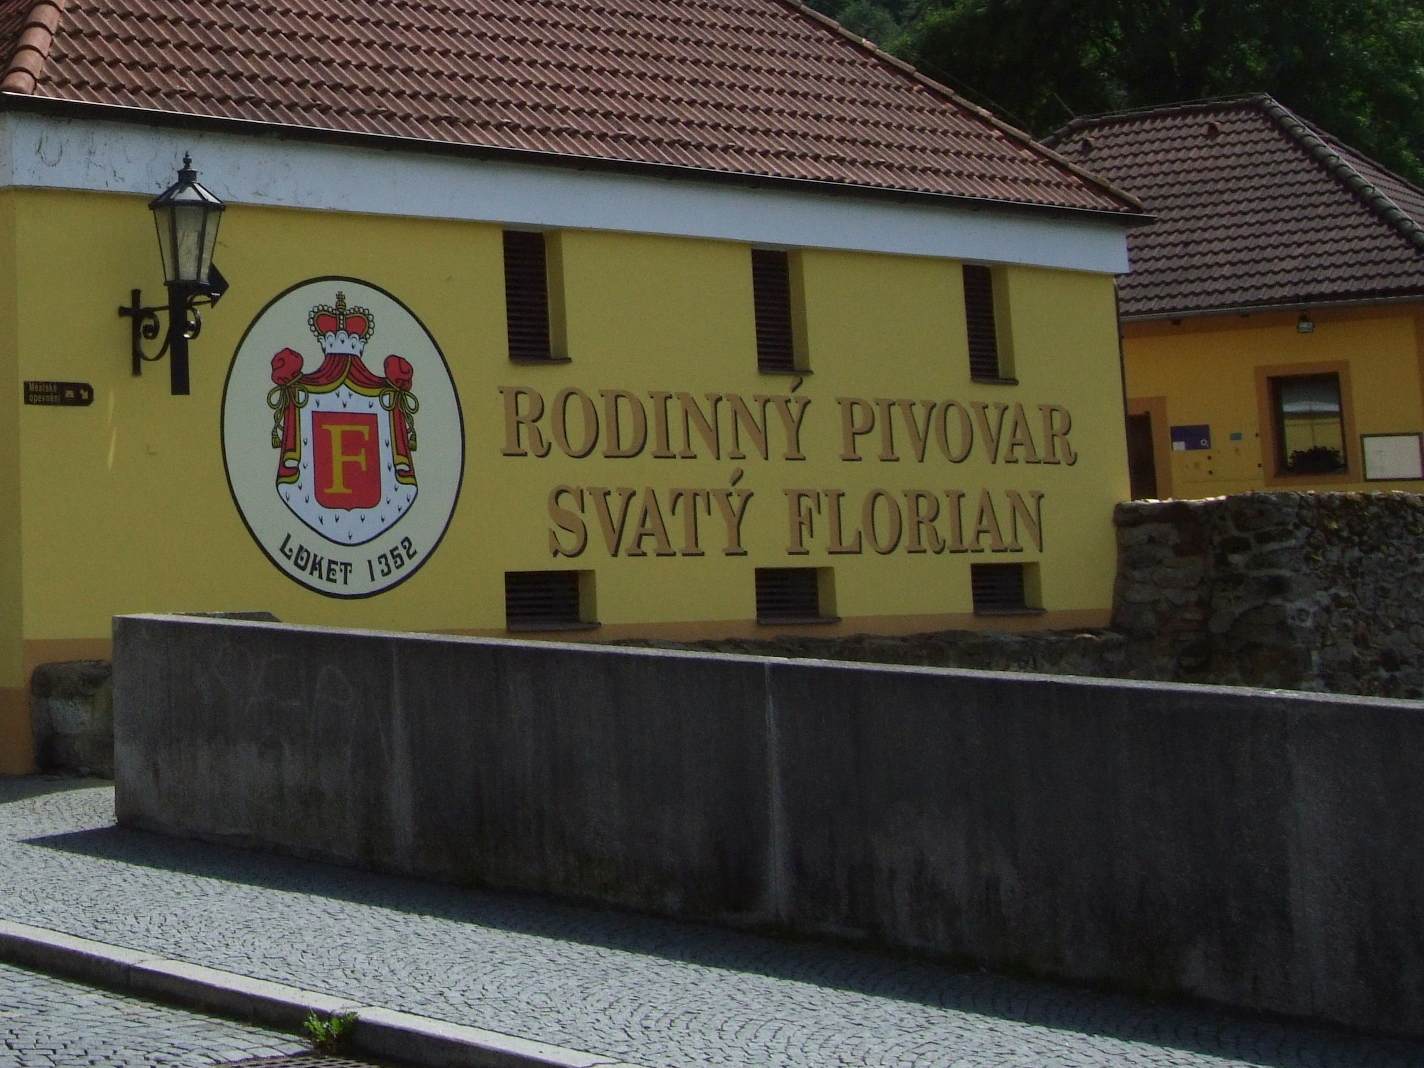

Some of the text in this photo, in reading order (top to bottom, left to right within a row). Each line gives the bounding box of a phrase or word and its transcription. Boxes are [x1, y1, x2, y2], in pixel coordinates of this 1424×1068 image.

[322, 424, 370, 494] F
[498, 378, 1078, 466] RODINNÝ PIVOVAR
[547, 469, 1045, 558] SVATÝ FLORIAN
[279, 533, 418, 586] LOKET 1352
